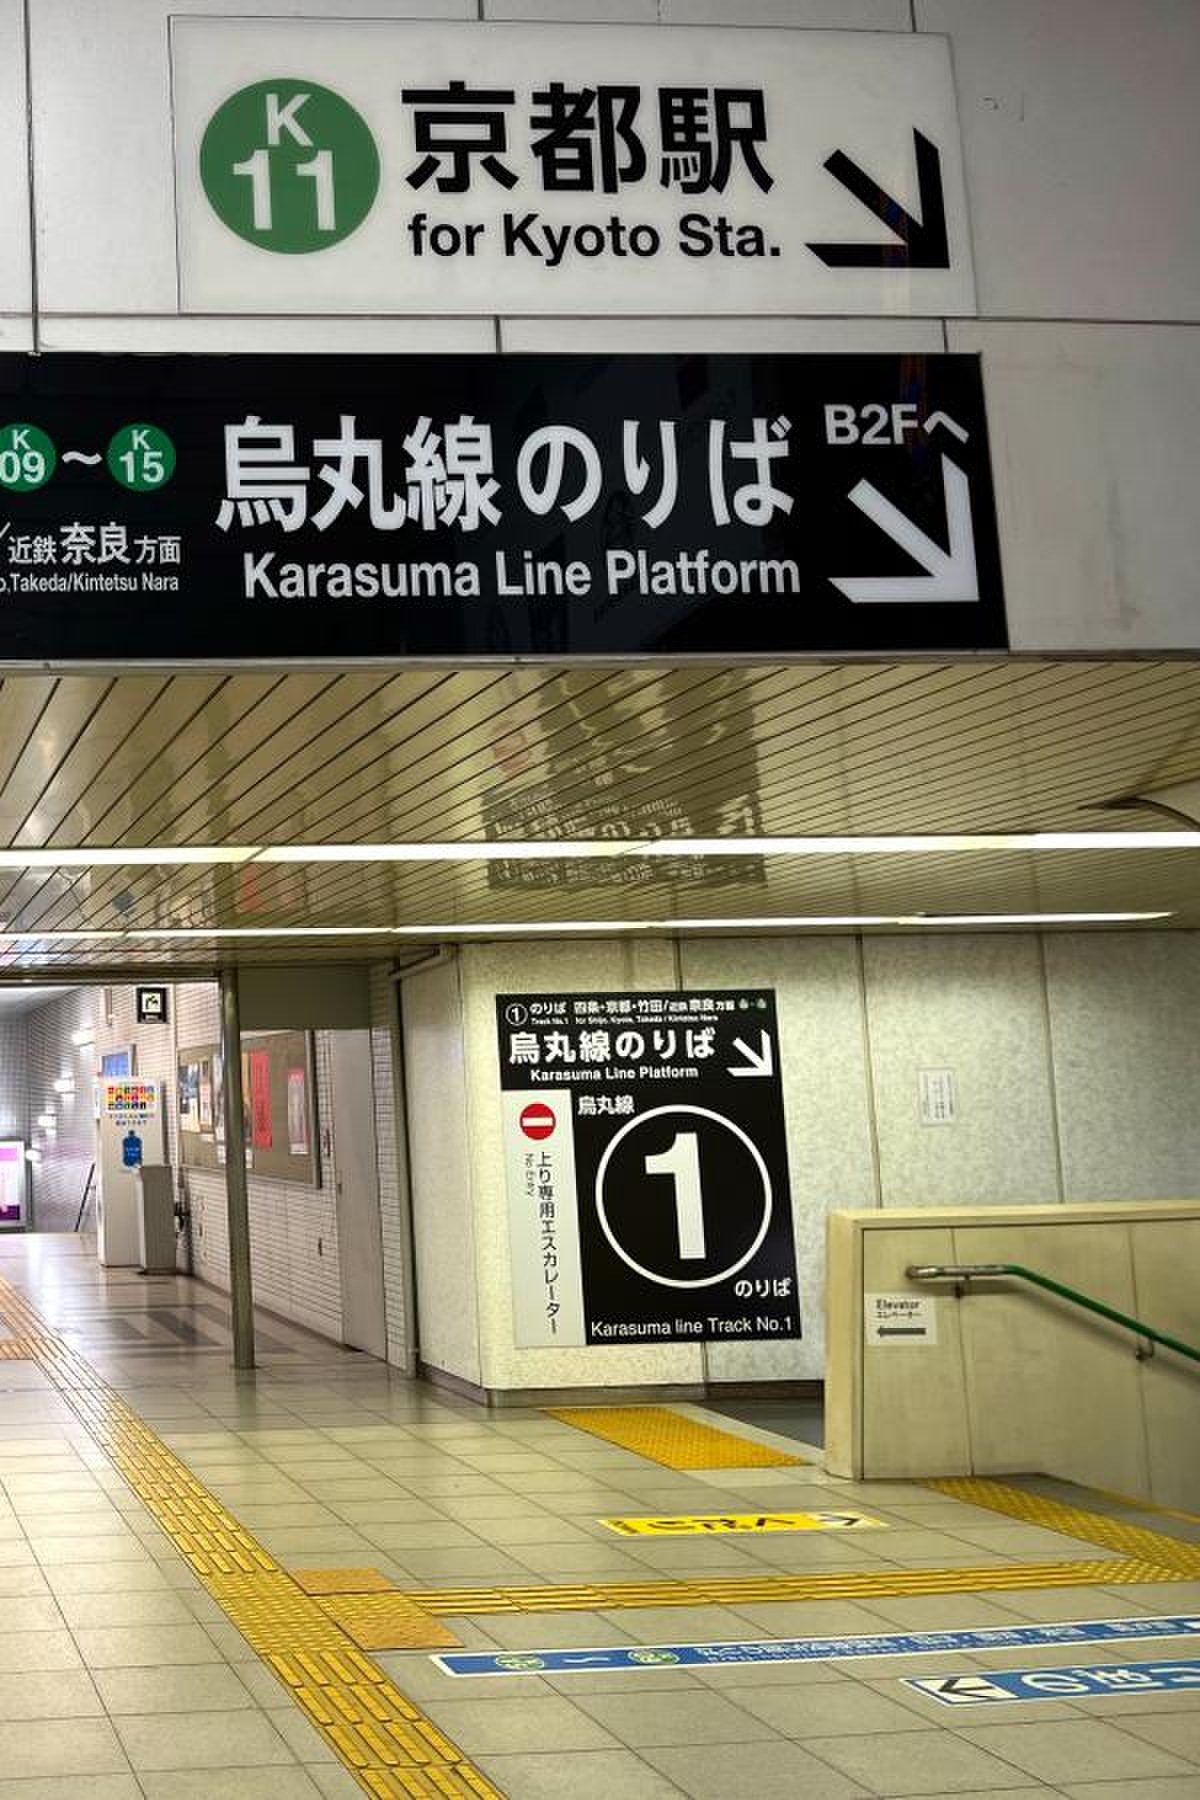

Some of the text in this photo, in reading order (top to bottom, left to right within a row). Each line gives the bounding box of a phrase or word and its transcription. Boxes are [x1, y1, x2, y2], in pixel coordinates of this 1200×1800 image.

[266, 93, 309, 147] K
[402, 80, 775, 195] 京都駅
[232, 148, 337, 232] 11
[408, 213, 782, 267] for Kyoto Sta.
[119, 450, 165, 483] 15
[214, 415, 795, 533] 烏丸線のりば
[141, 572, 180, 591] Nara
[243, 548, 801, 599] Karasuma Line Platform
[509, 1027, 717, 1065] 烏丸線のりば
[530, 1065, 699, 1082] Karasuma Line Platform
[578, 1095, 635, 1115] 烏丸線
[734, 1276, 792, 1298] のりば
[591, 1315, 792, 1337] Karasuma line Track No.1
